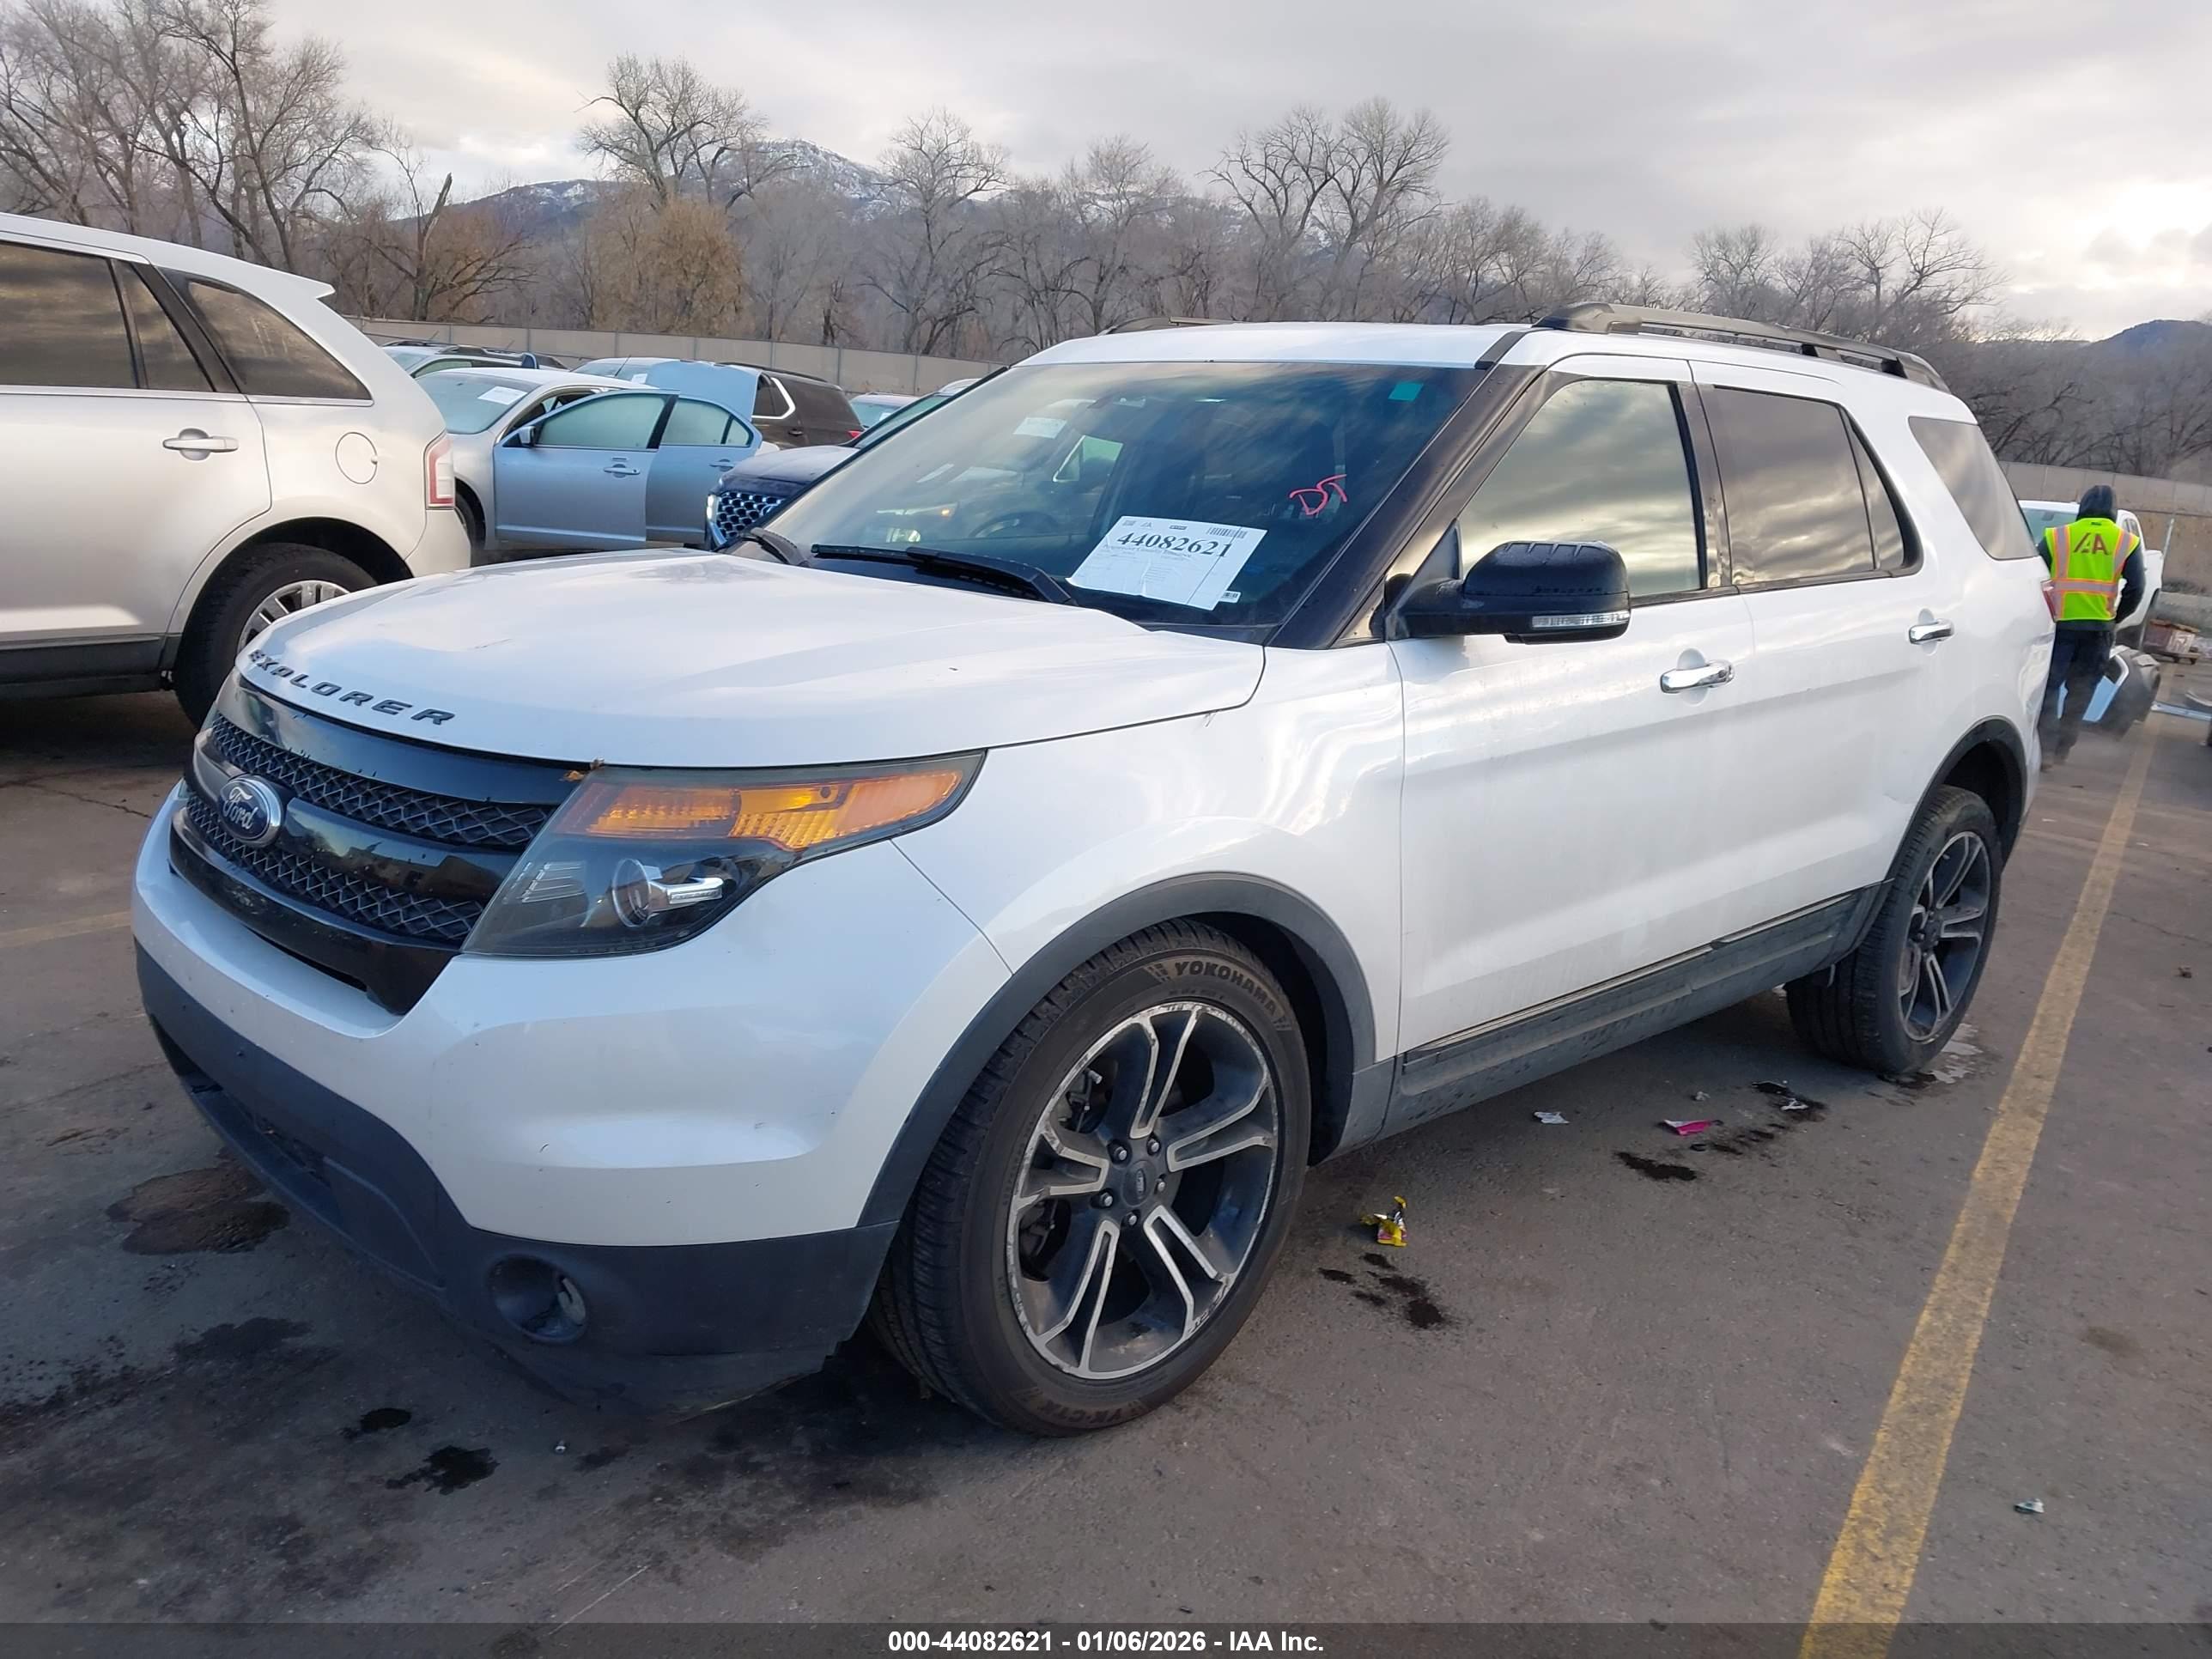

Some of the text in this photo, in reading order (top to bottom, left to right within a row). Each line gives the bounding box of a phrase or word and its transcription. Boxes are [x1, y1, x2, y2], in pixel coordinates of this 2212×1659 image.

[1117, 532, 1231, 557] 44082621
[248, 648, 455, 726] EXPLORER
[223, 787, 258, 830] Ford
[1175, 960, 1277, 1016] YOKOHAMA
